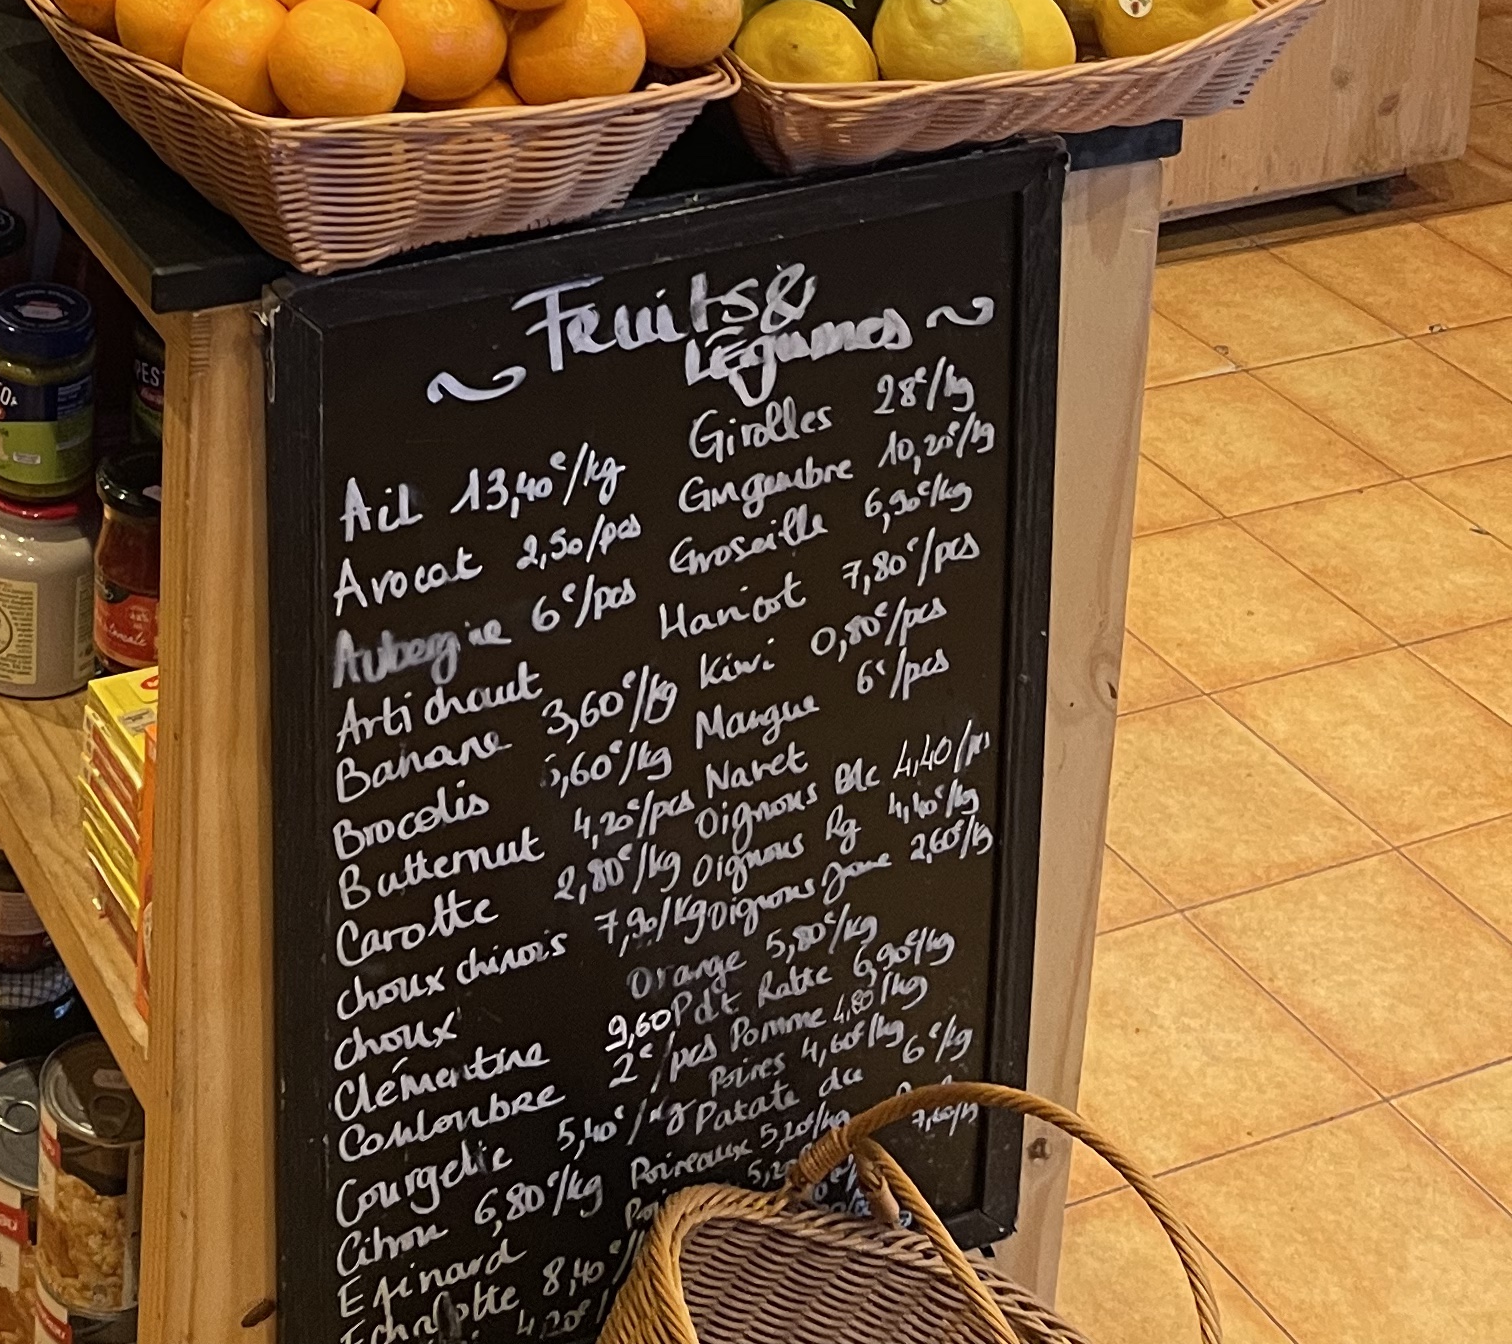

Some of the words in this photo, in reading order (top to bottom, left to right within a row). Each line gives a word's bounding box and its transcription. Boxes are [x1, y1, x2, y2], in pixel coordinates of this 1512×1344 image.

[512, 272, 760, 372] Fruits
[685, 326, 913, 407] Légumes
[689, 396, 832, 463] Girolles
[340, 477, 423, 542] Ail
[669, 503, 828, 575] Groseille
[333, 547, 483, 616] Avocat
[695, 695, 820, 750] Mangue
[337, 731, 512, 803] Banane
[333, 780, 489, 860] Brocolis
[695, 782, 818, 853] Oignons
[338, 827, 545, 910] Butternut
[692, 833, 804, 893] Oignons
[336, 890, 498, 967] Carotte
[628, 951, 747, 999] Orange
[730, 1008, 827, 1053] Pomme
[695, 1085, 800, 1135] Patate
